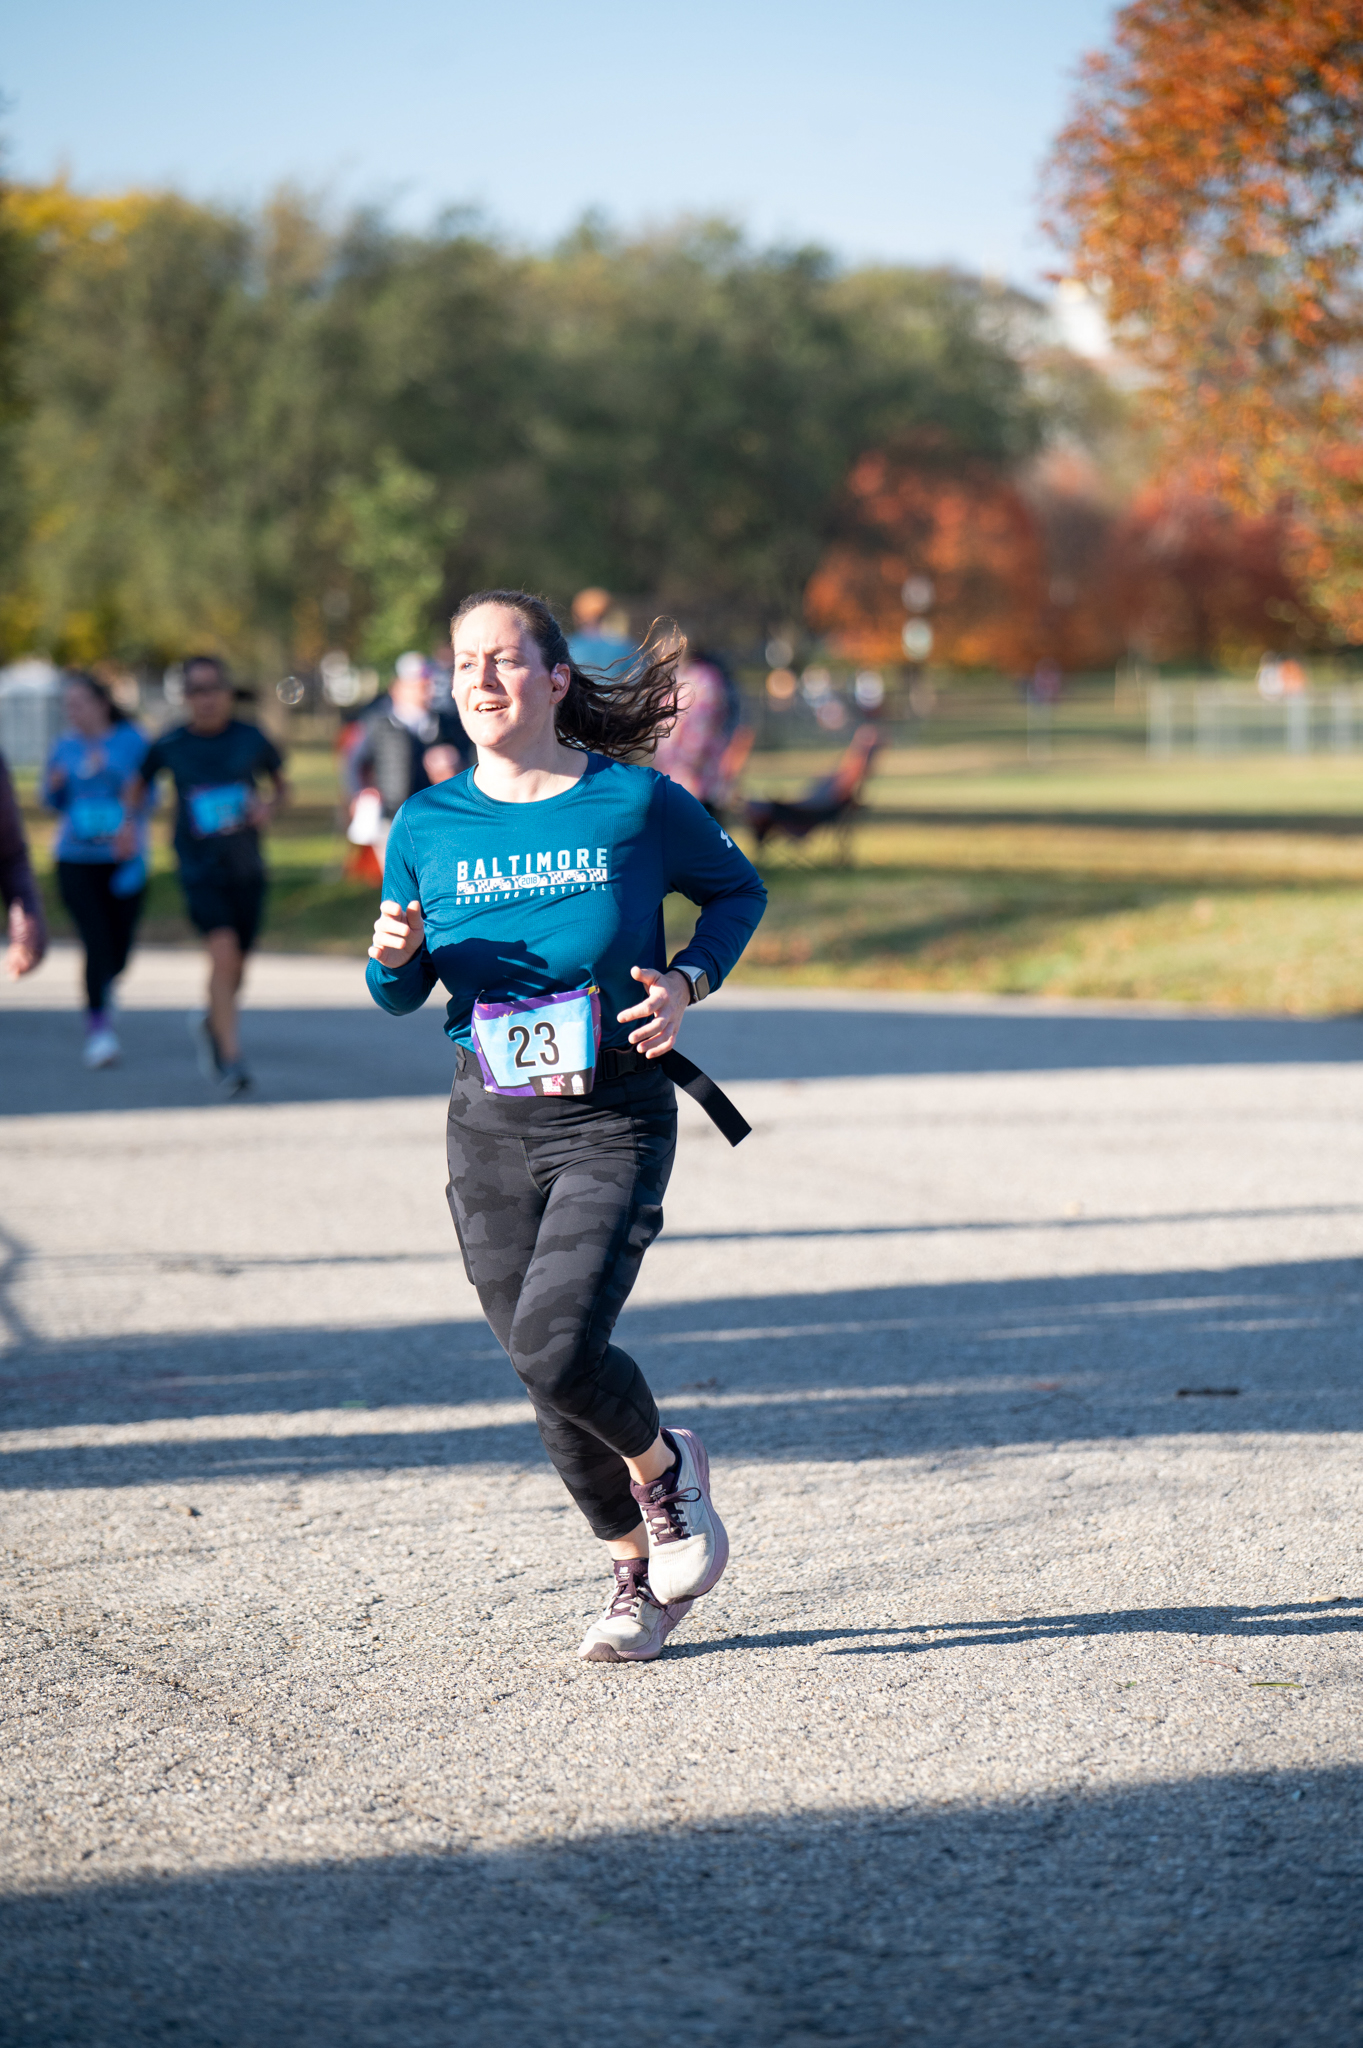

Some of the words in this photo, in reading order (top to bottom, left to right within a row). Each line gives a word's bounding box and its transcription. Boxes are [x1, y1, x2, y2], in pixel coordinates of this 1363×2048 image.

[457, 847, 608, 882] BALTIMORE
[521, 876, 538, 885] 2018
[456, 890, 520, 906] RUNNING
[530, 883, 607, 897] FESTIVAL
[508, 1021, 560, 1069] 23
[551, 1075, 566, 1086] 5K
